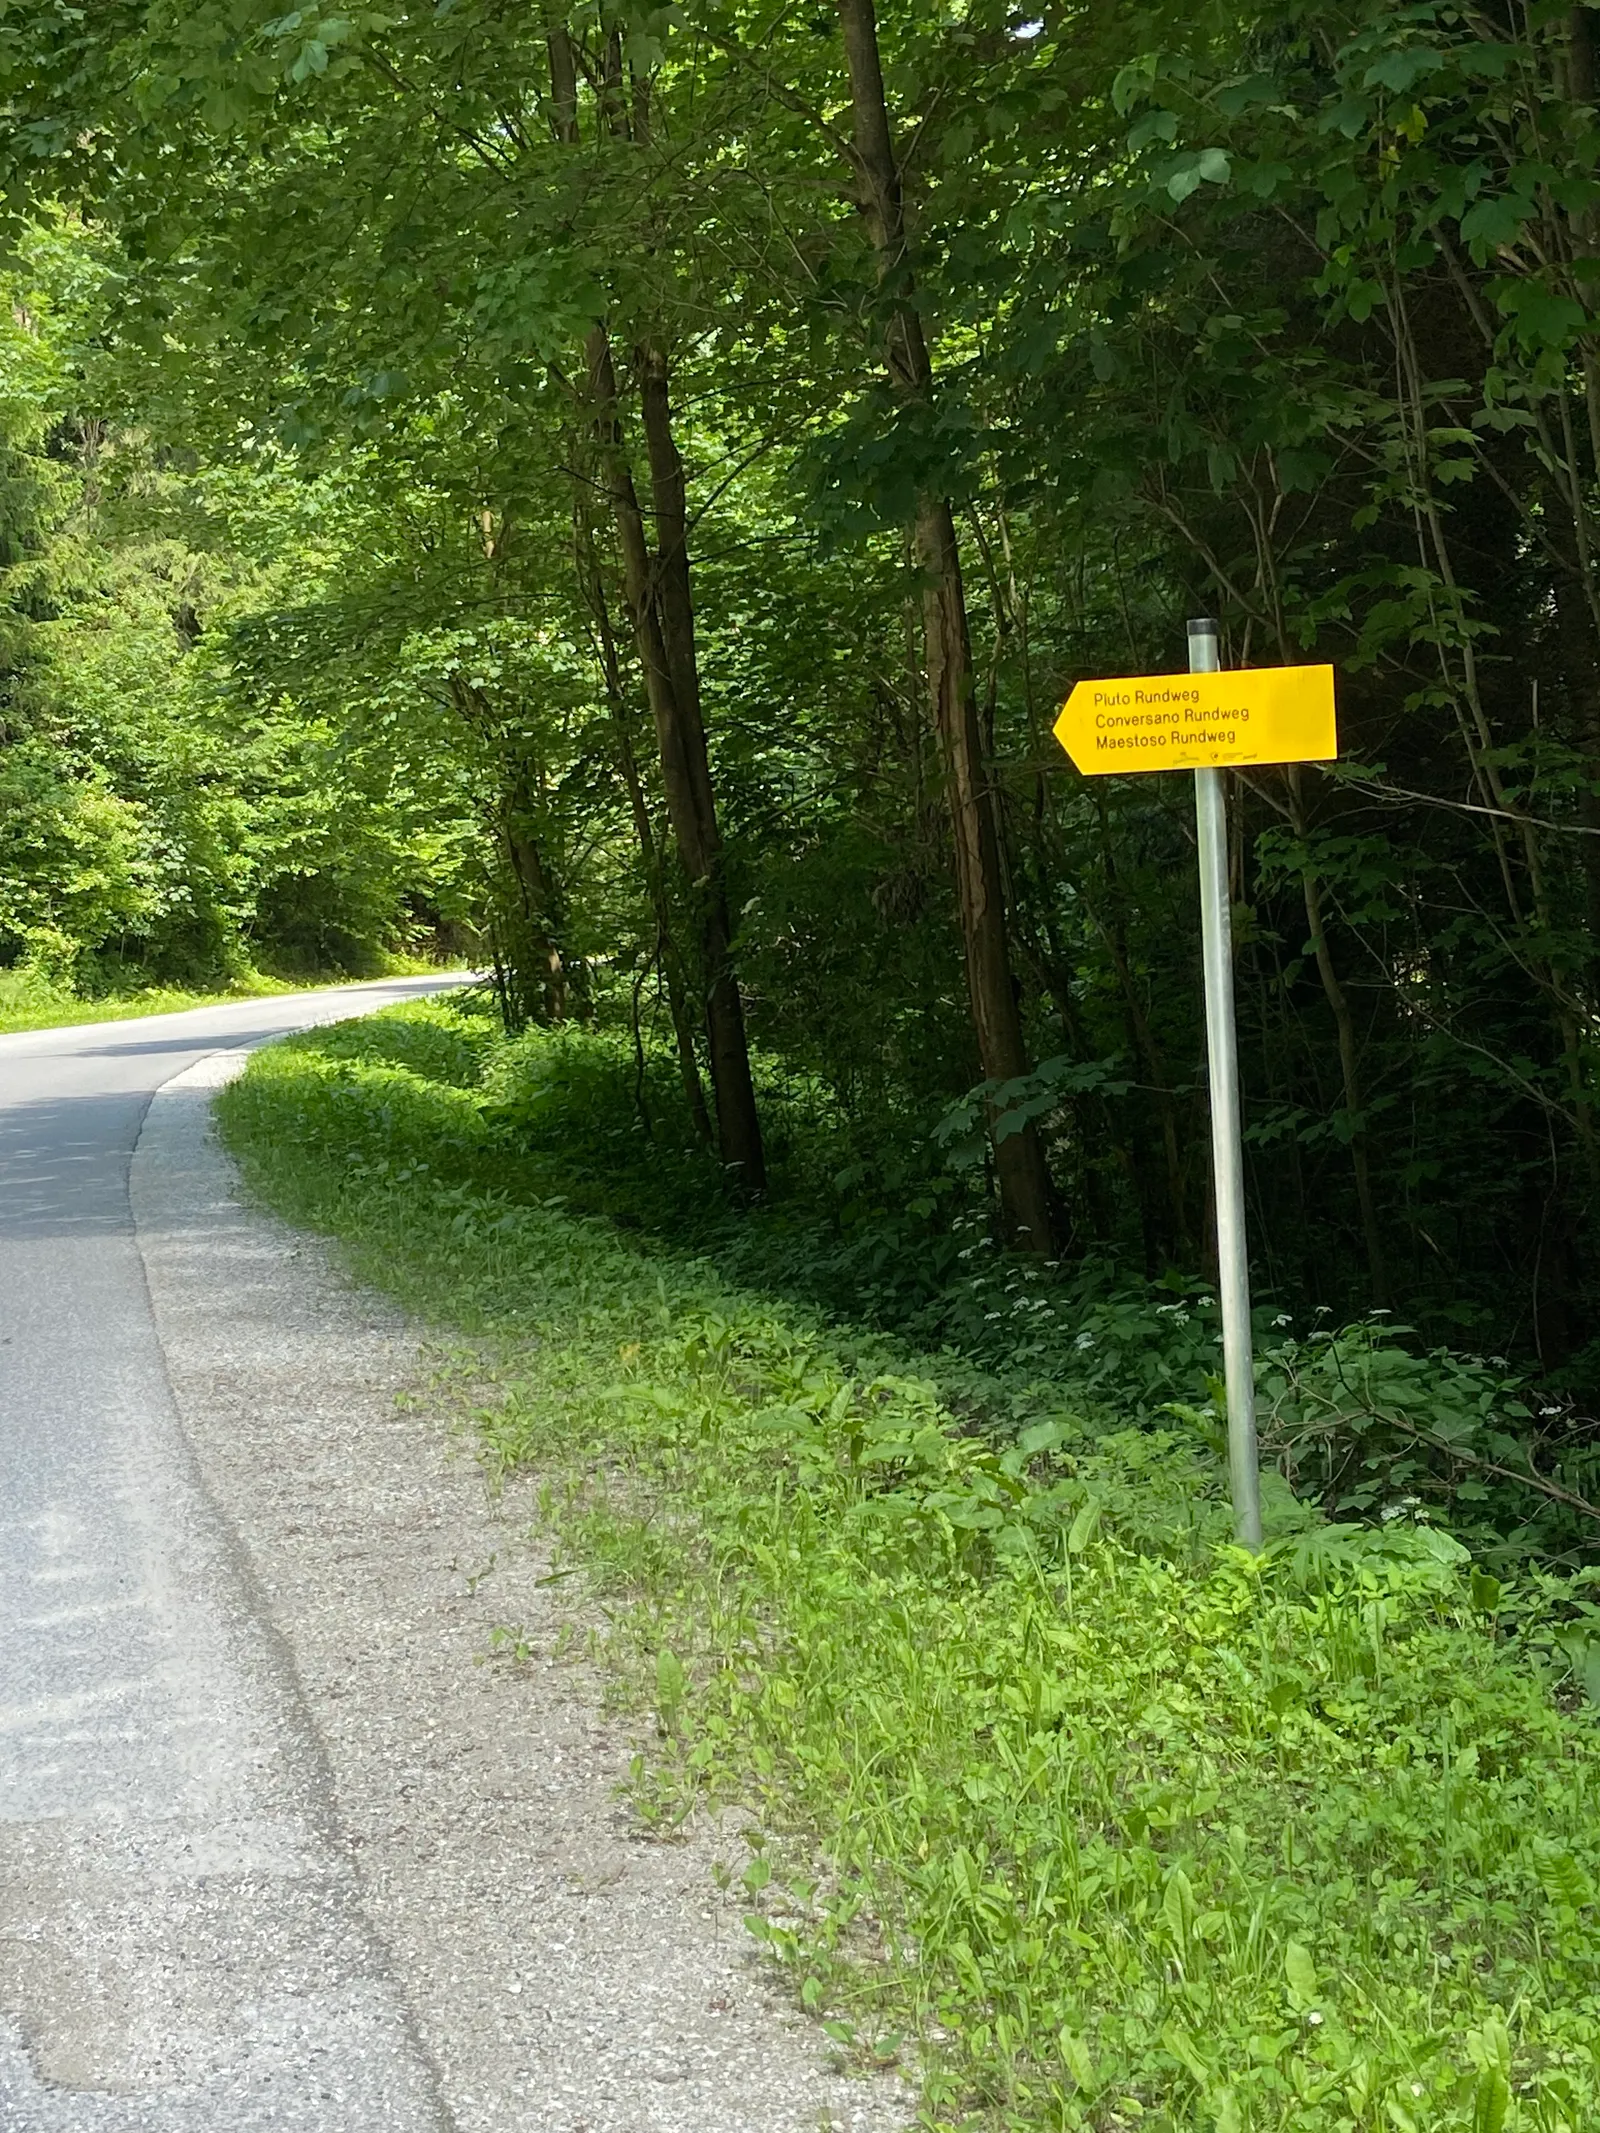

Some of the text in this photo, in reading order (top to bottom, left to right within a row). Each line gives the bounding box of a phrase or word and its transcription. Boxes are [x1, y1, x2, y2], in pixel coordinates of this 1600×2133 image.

[1094, 689, 1200, 707] Pluto Rundweg
[1095, 707, 1250, 728] Conversano Rundweg
[1096, 730, 1236, 750] Maestoso Rundweg
